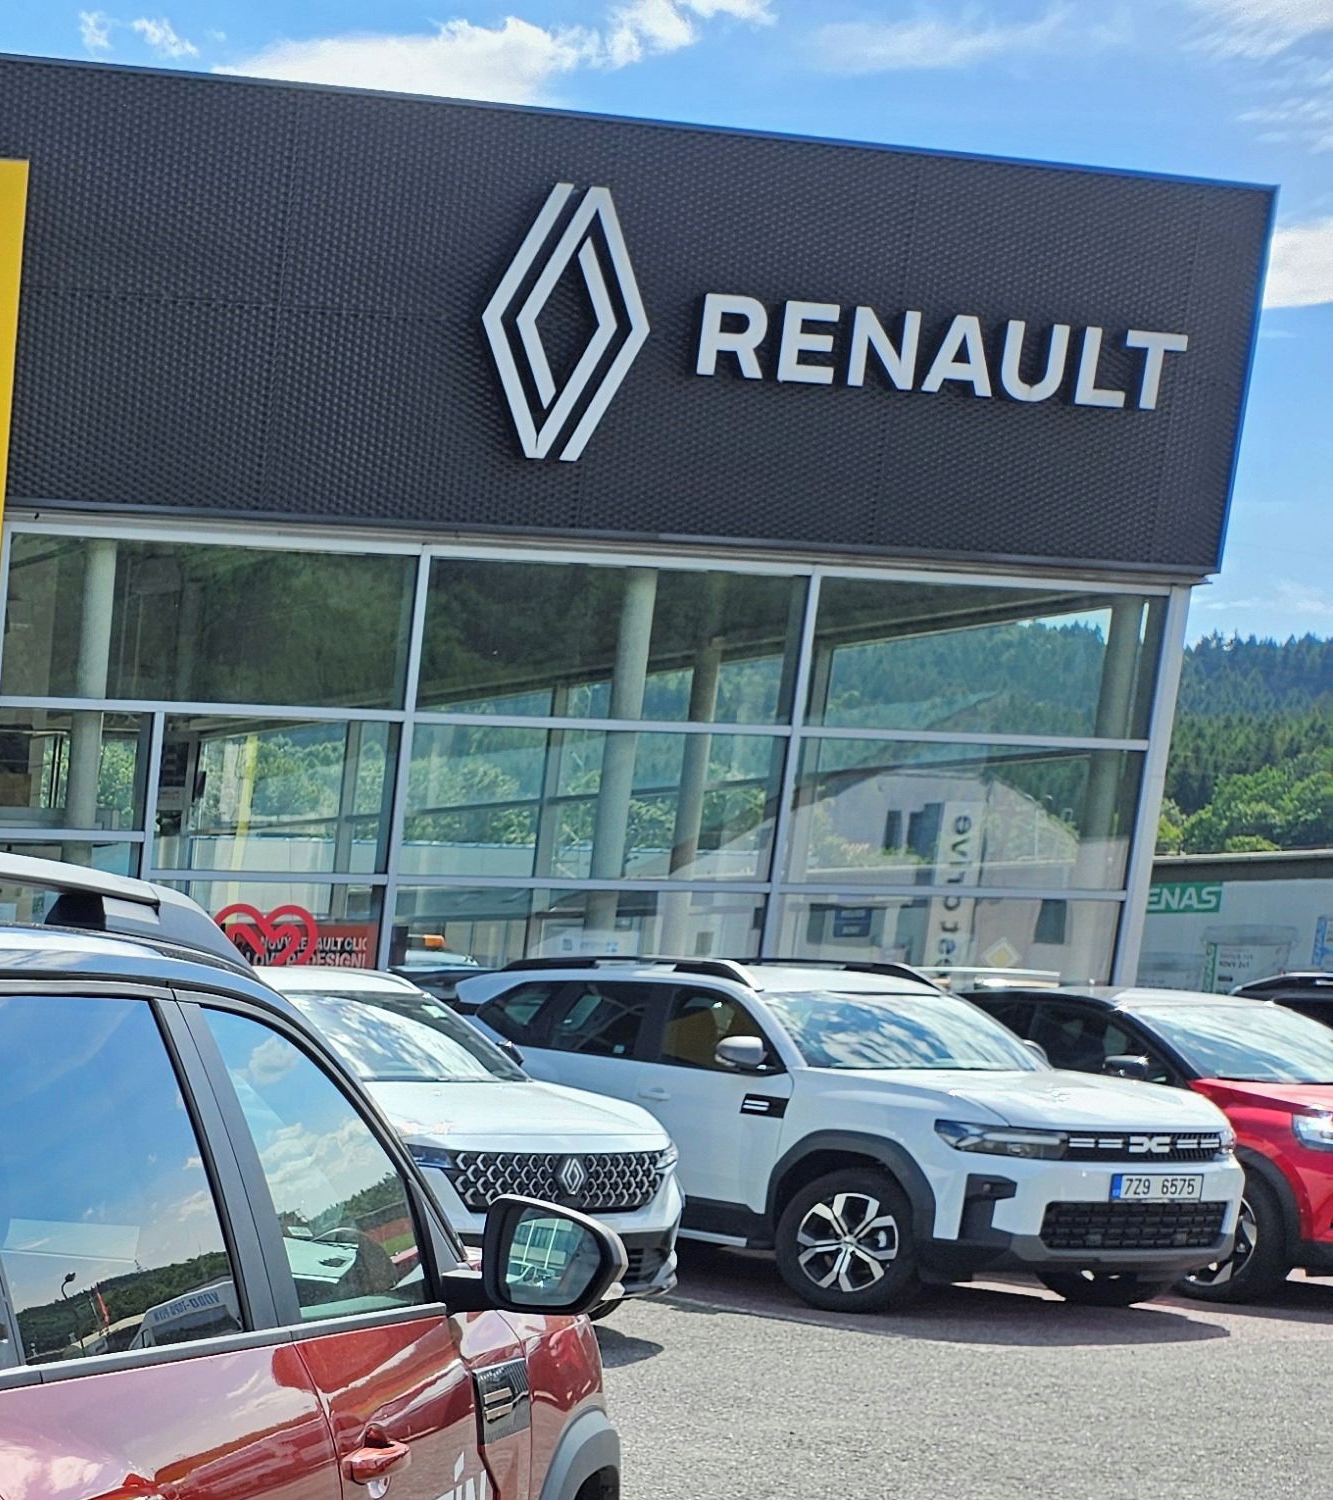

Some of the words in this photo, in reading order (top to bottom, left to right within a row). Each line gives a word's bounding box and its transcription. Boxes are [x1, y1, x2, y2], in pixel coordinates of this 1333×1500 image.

[695, 292, 1188, 410] RENAULT
[1147, 886, 1221, 911] ENAS
[1124, 1178, 1151, 1195] 7Z9
[1161, 1178, 1195, 1195] 6575
